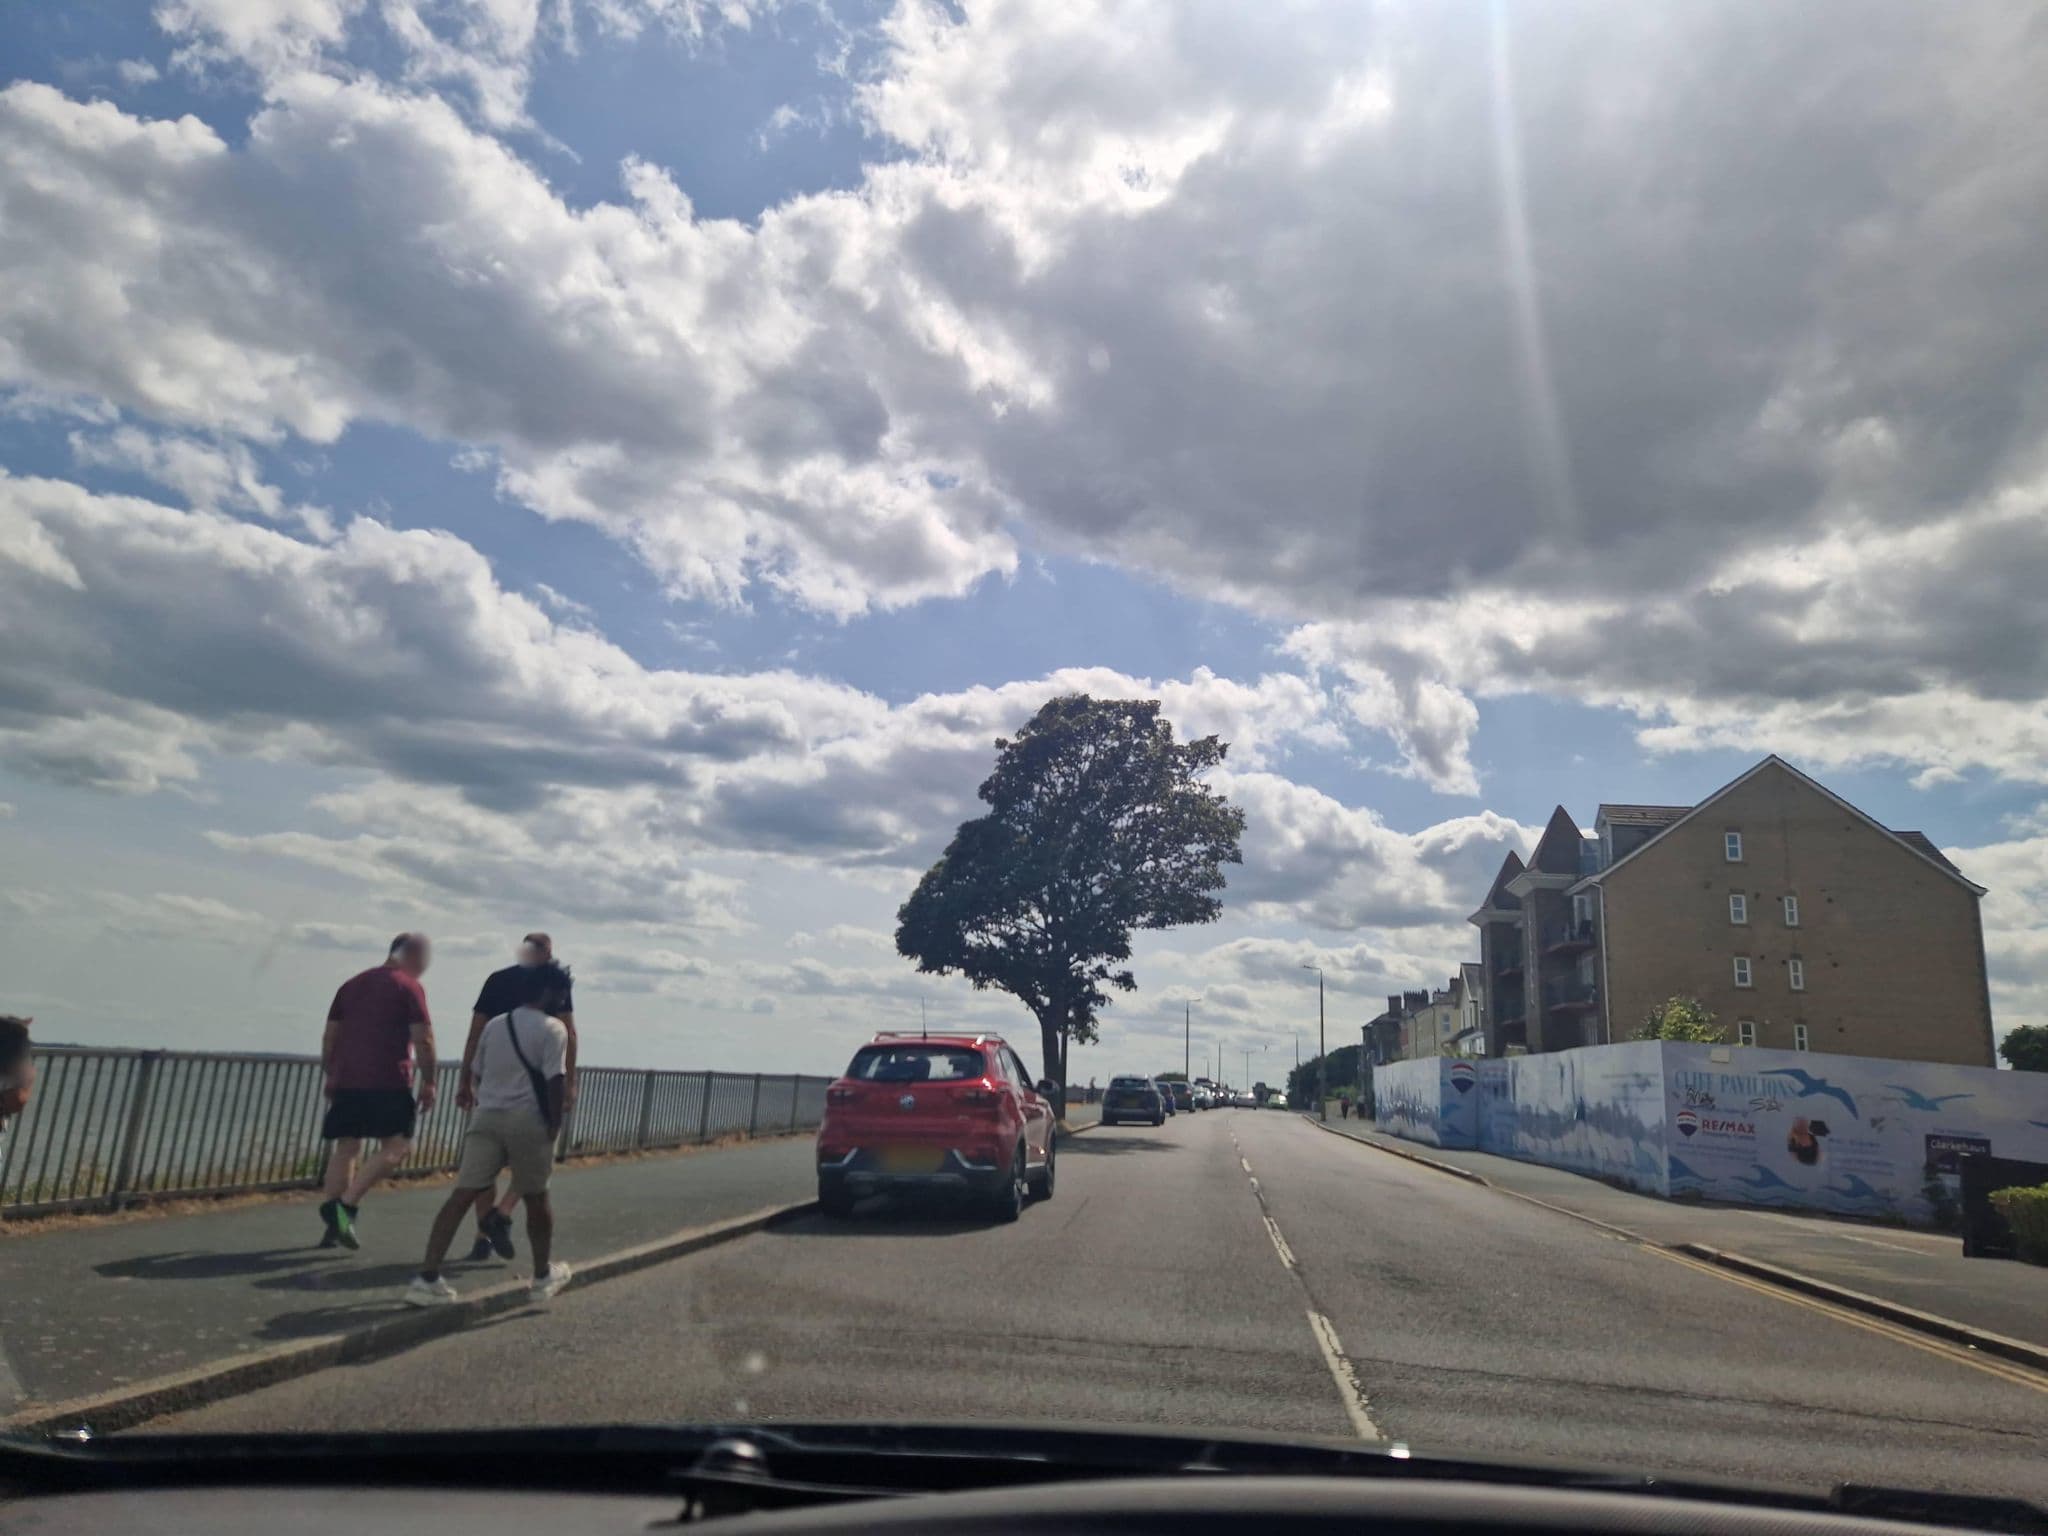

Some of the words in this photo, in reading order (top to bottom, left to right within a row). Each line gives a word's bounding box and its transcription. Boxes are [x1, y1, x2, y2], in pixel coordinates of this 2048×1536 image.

[1674, 1071, 1713, 1090] CLIFF
[1720, 1073, 1801, 1099] PAVILIONS
[1702, 1119, 1757, 1135] RE/MAX
